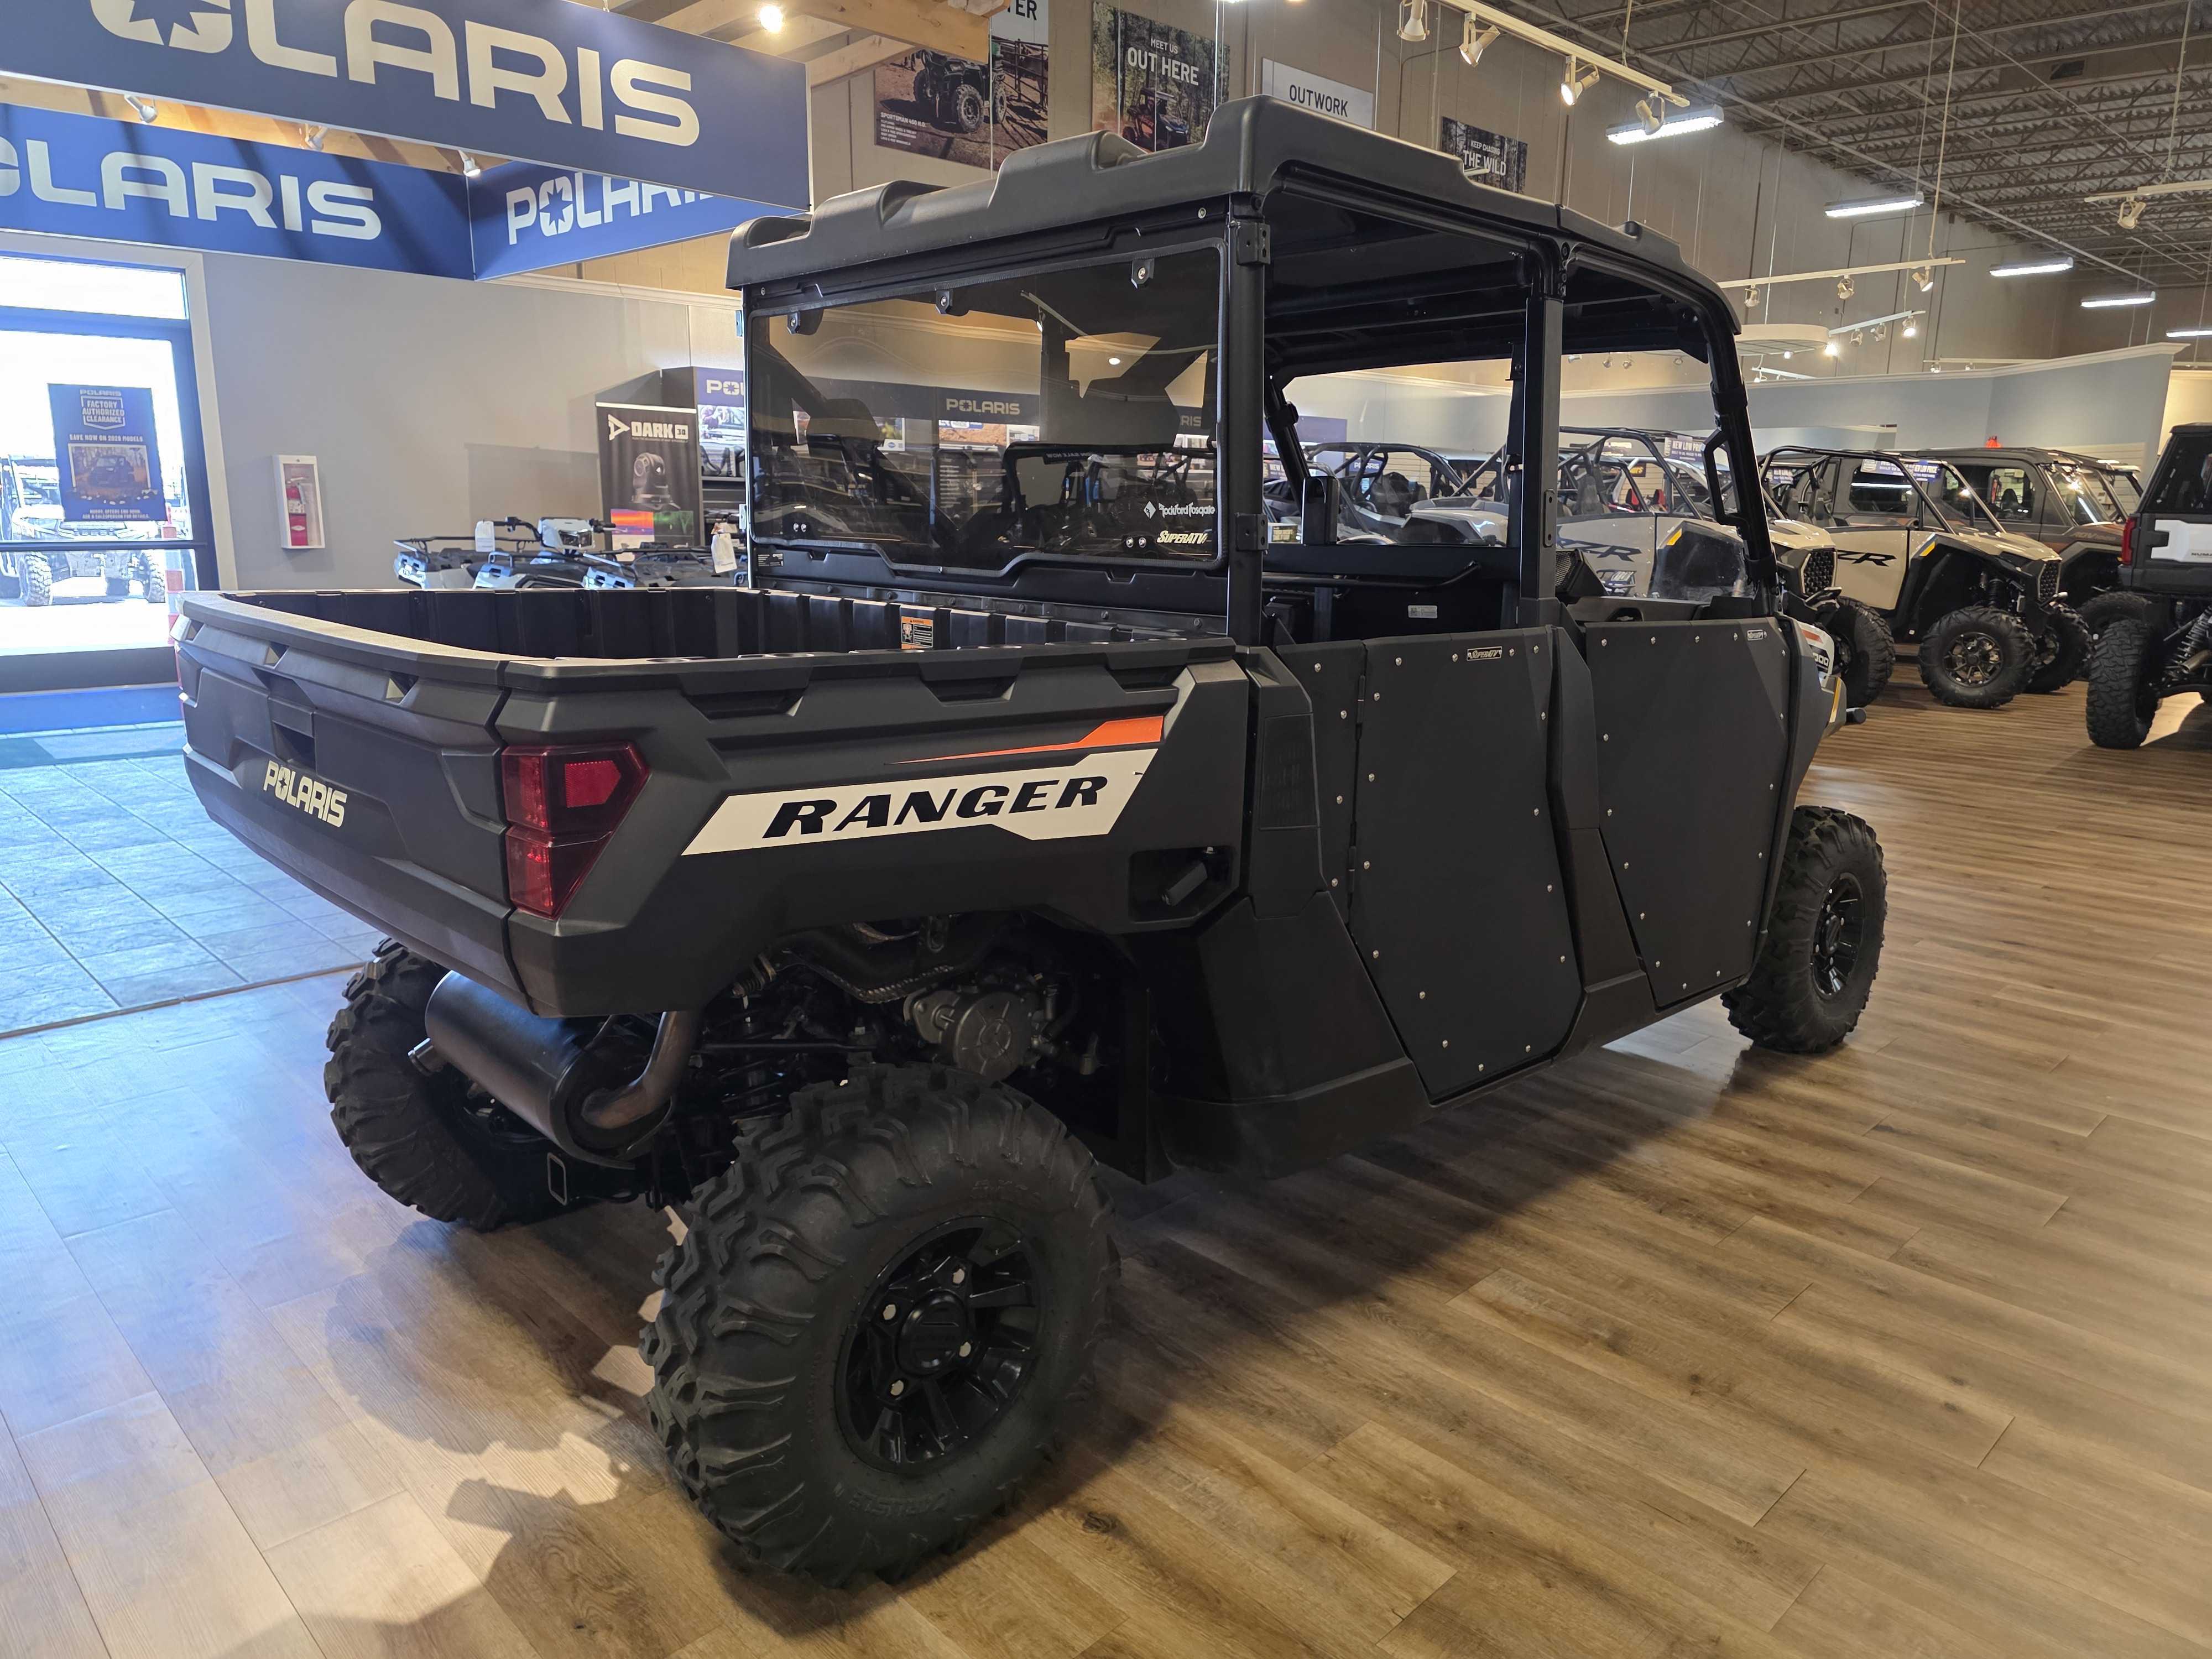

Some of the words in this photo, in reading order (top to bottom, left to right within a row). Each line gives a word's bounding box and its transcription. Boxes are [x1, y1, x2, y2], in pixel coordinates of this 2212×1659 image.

[1006, 0, 1037, 20] ER
[1151, 38, 1168, 51] MEET
[1169, 44, 1178, 54] US
[90, 0, 700, 146] OLARIS
[1127, 47, 1157, 72] OUT
[1161, 58, 1199, 86] HERE
[1289, 85, 1348, 117] OUTWORK
[1471, 140, 1482, 149] KEEP
[1482, 143, 1500, 155] CHASING
[1463, 149, 1482, 168] THE
[1483, 155, 1506, 176] WILD
[0, 136, 382, 240] LARIS
[82, 408, 124, 417] AUTHORIZED
[86, 400, 117, 409] FACTORY
[946, 398, 1020, 415] POLARIS
[86, 415, 122, 424] CLEARANCE
[1180, 415, 1202, 427] RIS
[630, 421, 674, 439] DARK
[1837, 549, 1897, 567] ZR
[263, 760, 348, 828] POLARIS
[762, 775, 1108, 839] RANGER
